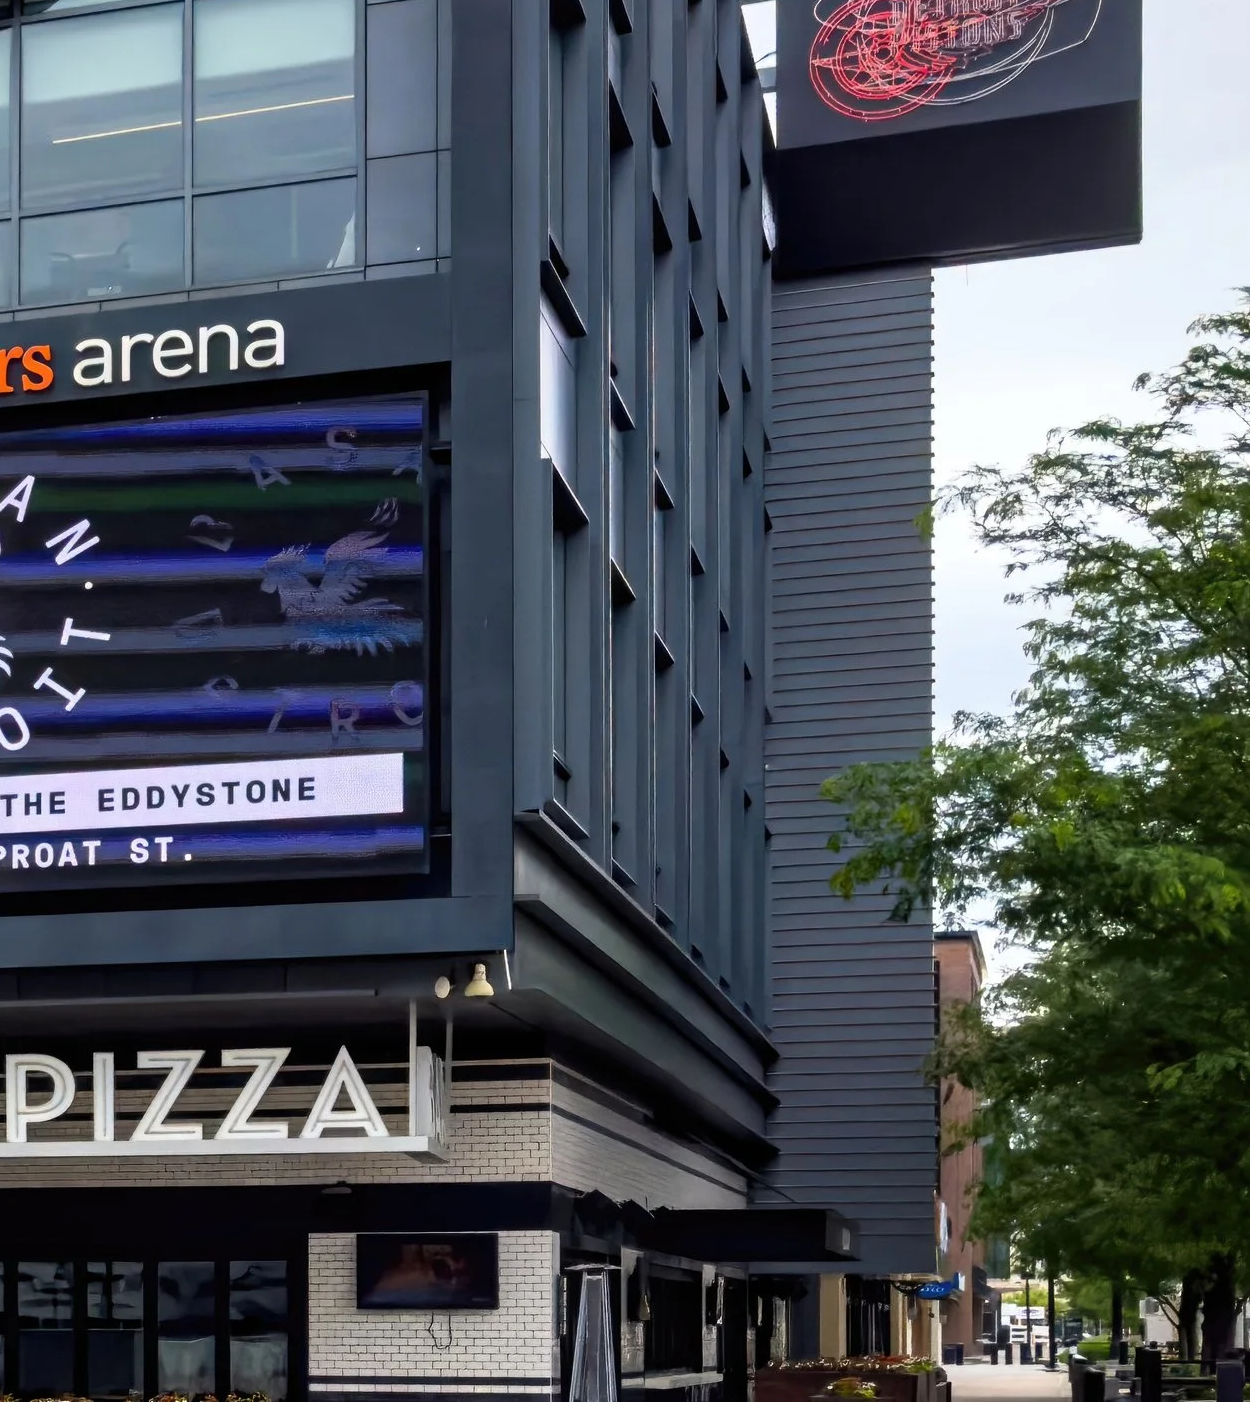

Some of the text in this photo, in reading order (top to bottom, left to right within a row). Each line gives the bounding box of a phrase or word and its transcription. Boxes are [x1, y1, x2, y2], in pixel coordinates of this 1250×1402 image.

[72, 318, 286, 388] arena
[0, 791, 66, 817] THE
[98, 777, 316, 812] EDDYSTONE
[129, 836, 194, 864] ST.
[5, 1044, 391, 1144] PIZZA
